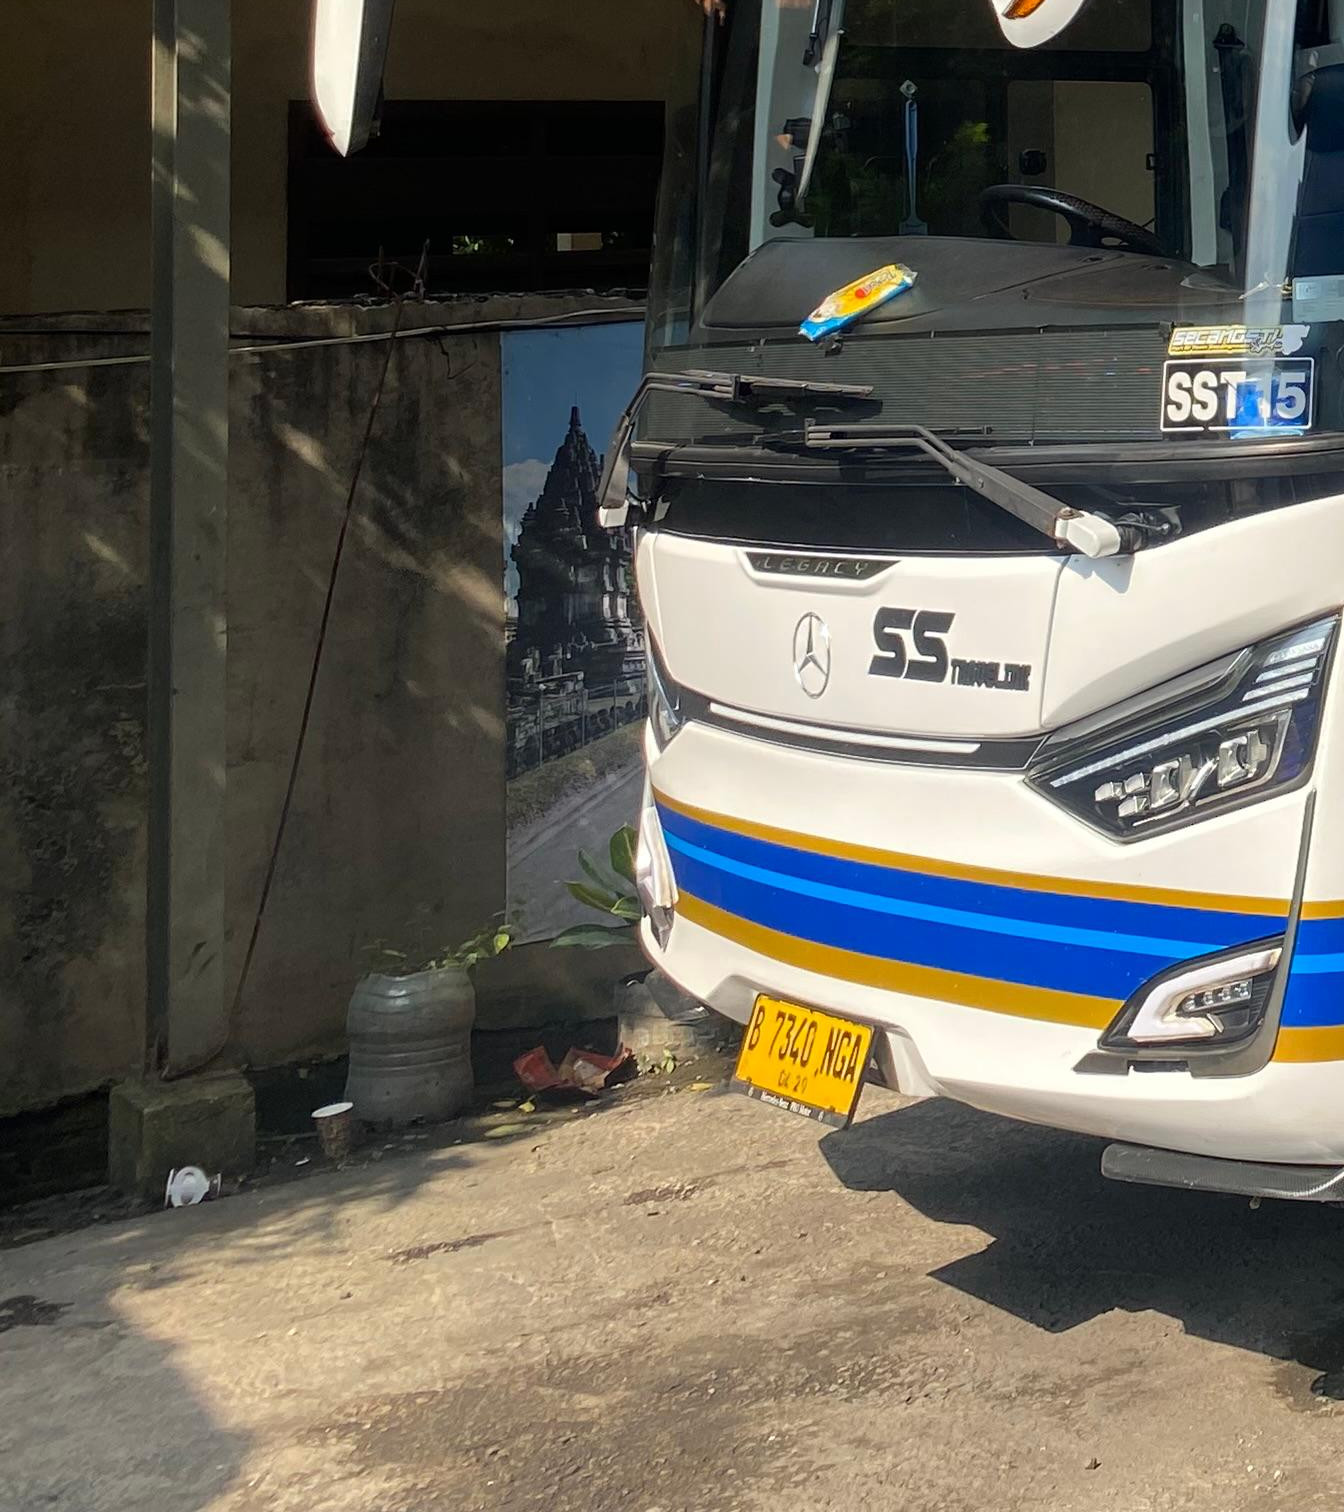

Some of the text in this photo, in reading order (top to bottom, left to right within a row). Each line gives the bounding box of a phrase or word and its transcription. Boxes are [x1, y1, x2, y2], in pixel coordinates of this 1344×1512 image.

[1166, 371, 1306, 423] SST 15
[763, 556, 869, 576] LEGACY
[868, 606, 956, 683] SS
[748, 1005, 862, 1084] B 7340 NGA
